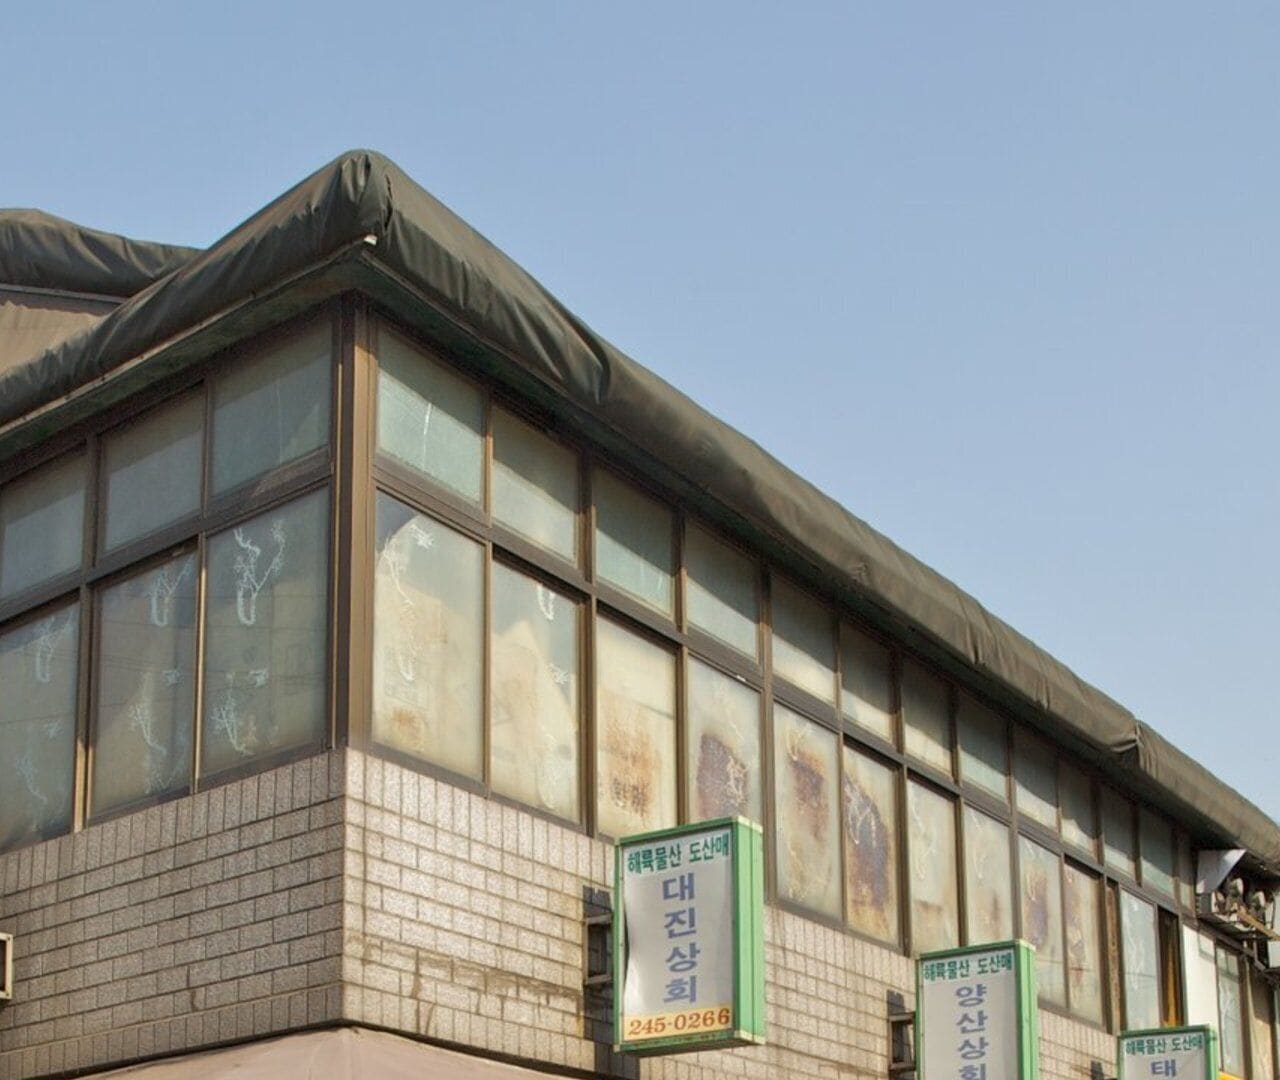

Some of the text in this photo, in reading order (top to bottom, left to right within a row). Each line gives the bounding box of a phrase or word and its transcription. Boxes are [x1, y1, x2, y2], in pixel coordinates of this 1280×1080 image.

[628, 832, 730, 875] 해륙물산 도산매
[662, 872, 701, 1004] 대진상회
[923, 952, 1013, 982] 해륙물산 도산매
[629, 1007, 731, 1037] 245-0266
